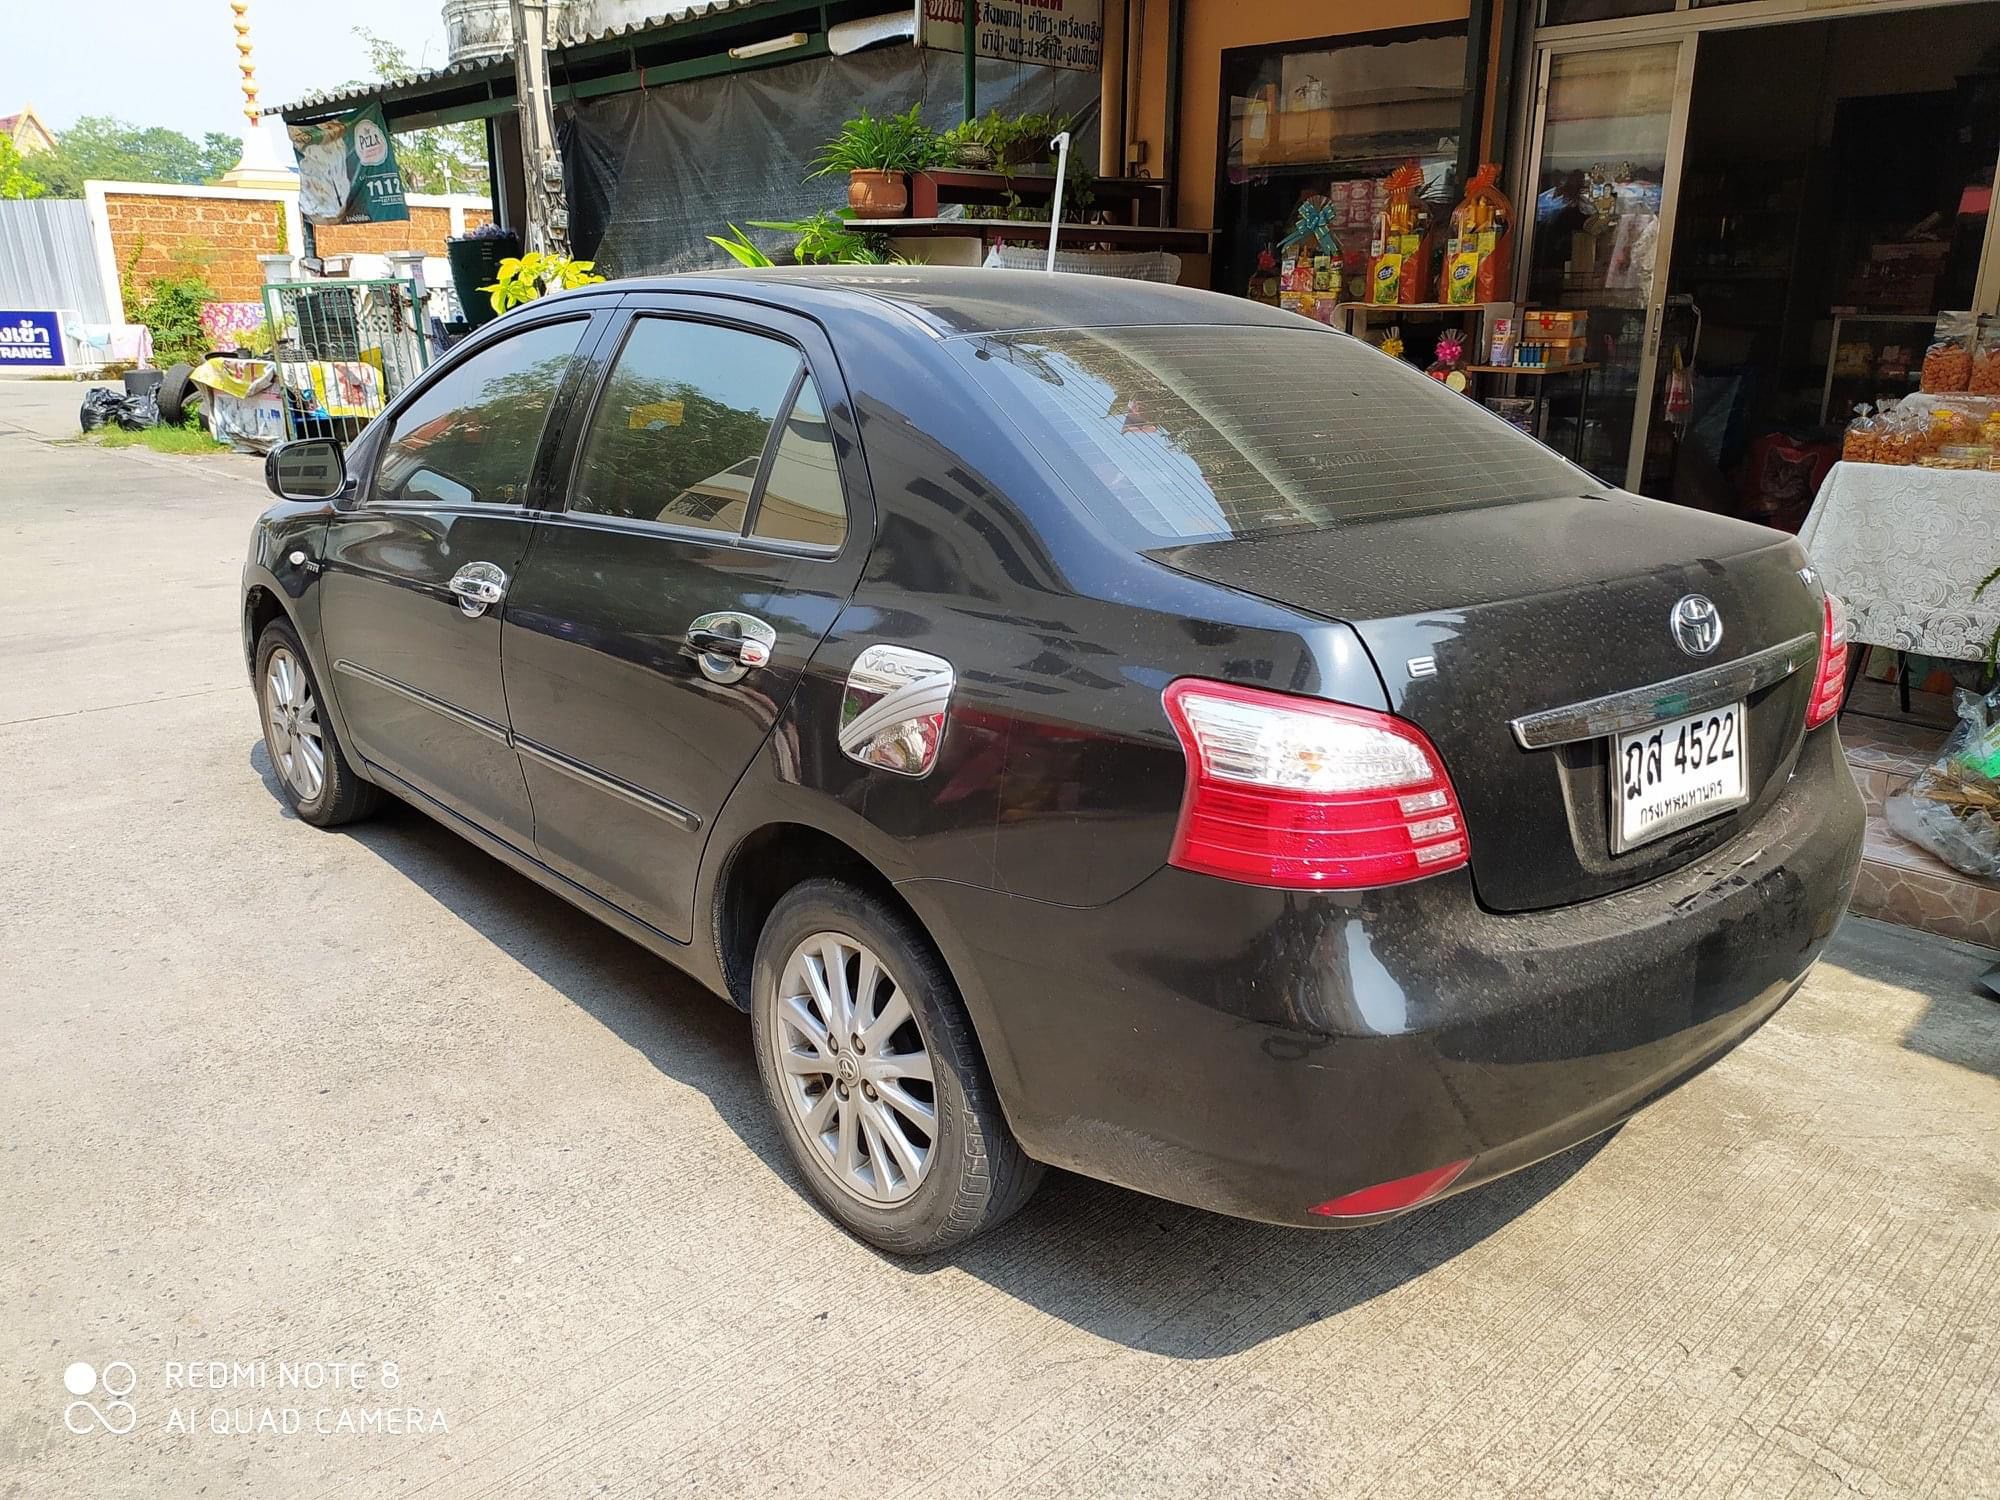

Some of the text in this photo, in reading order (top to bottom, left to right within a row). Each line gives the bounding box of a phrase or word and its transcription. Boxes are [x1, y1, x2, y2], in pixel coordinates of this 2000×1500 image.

[366, 177, 402, 197] 1112
[0, 346, 53, 359] RANCE
[1406, 655, 1438, 678] E
[1674, 711, 1734, 774] 4522
[1640, 779, 1723, 825] กรงเทพมหานคร
